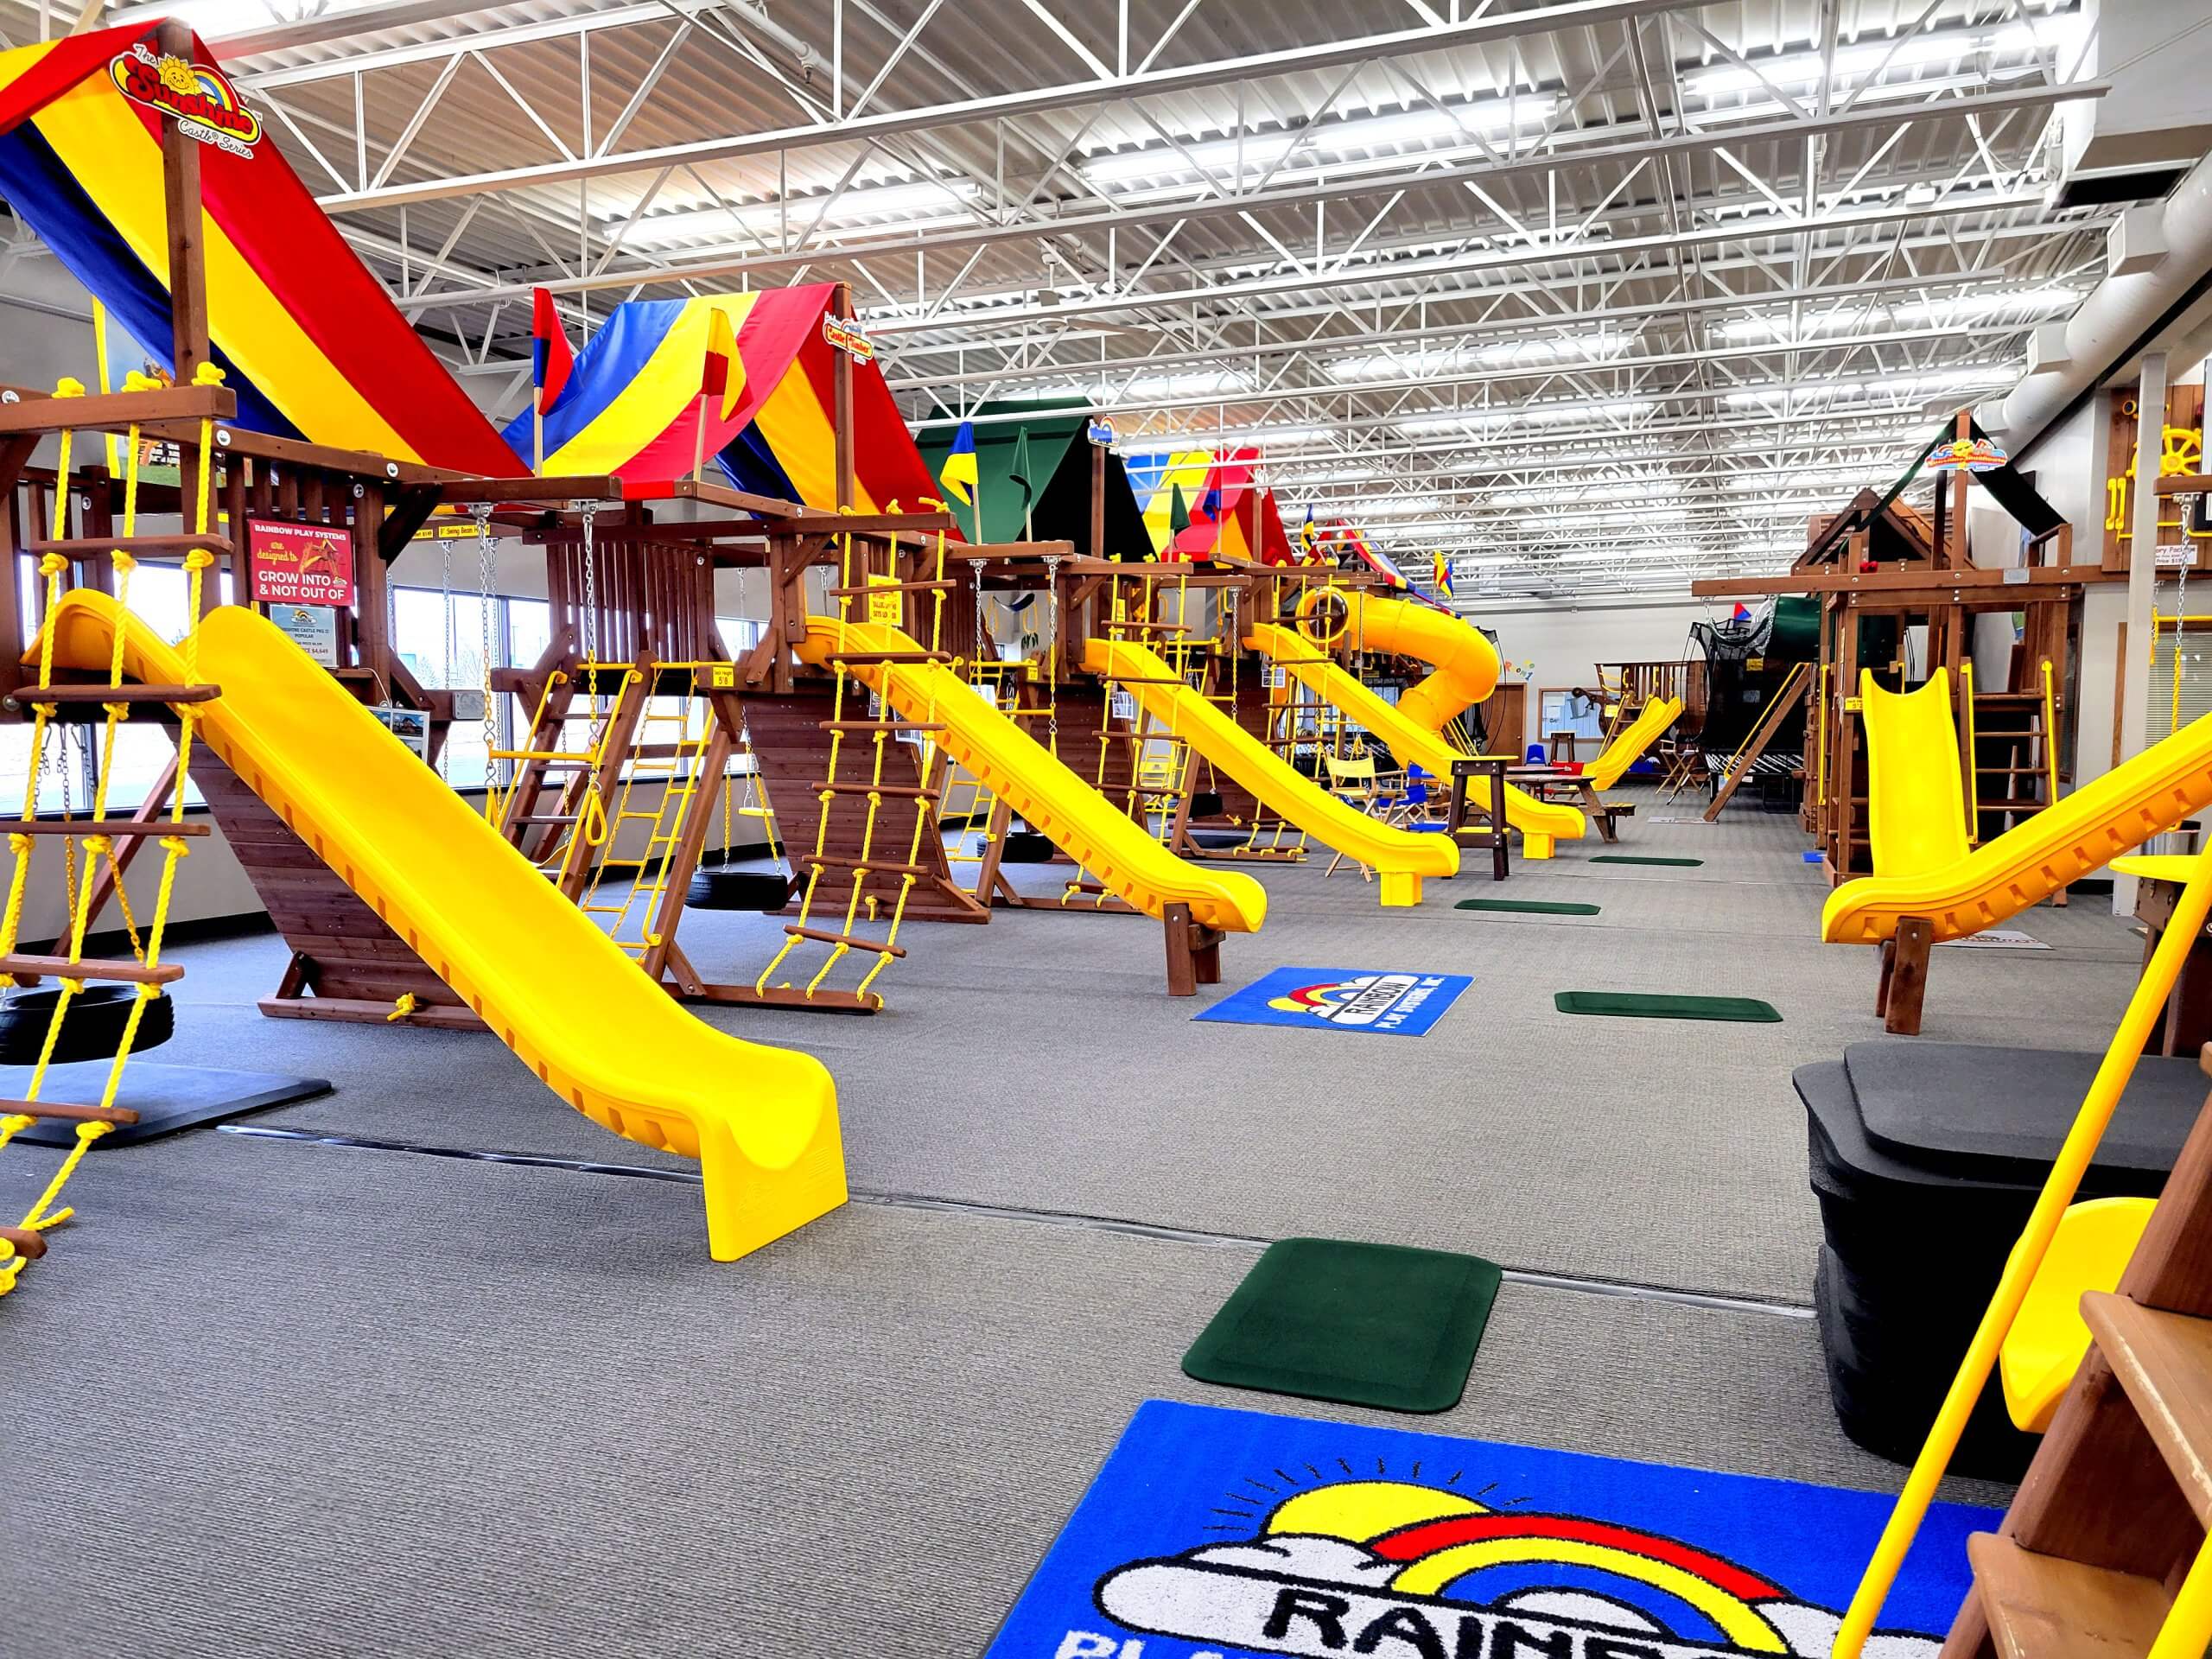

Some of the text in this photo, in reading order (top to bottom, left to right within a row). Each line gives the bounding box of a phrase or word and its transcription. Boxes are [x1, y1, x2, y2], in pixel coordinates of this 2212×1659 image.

[135, 45, 156, 64] The
[124, 54, 253, 135] Sunshine
[219, 137, 252, 158] Series
[254, 524, 346, 541] RAINBOW PLAY SYSTEMS
[257, 547, 299, 567] designed to
[258, 570, 299, 584] GROW
[302, 574, 331, 587] INTO
[259, 583, 346, 600] & NOT OUT OF
[1344, 982, 1408, 1015] RAINBOW
[1260, 1586, 1673, 1659] RAIN
